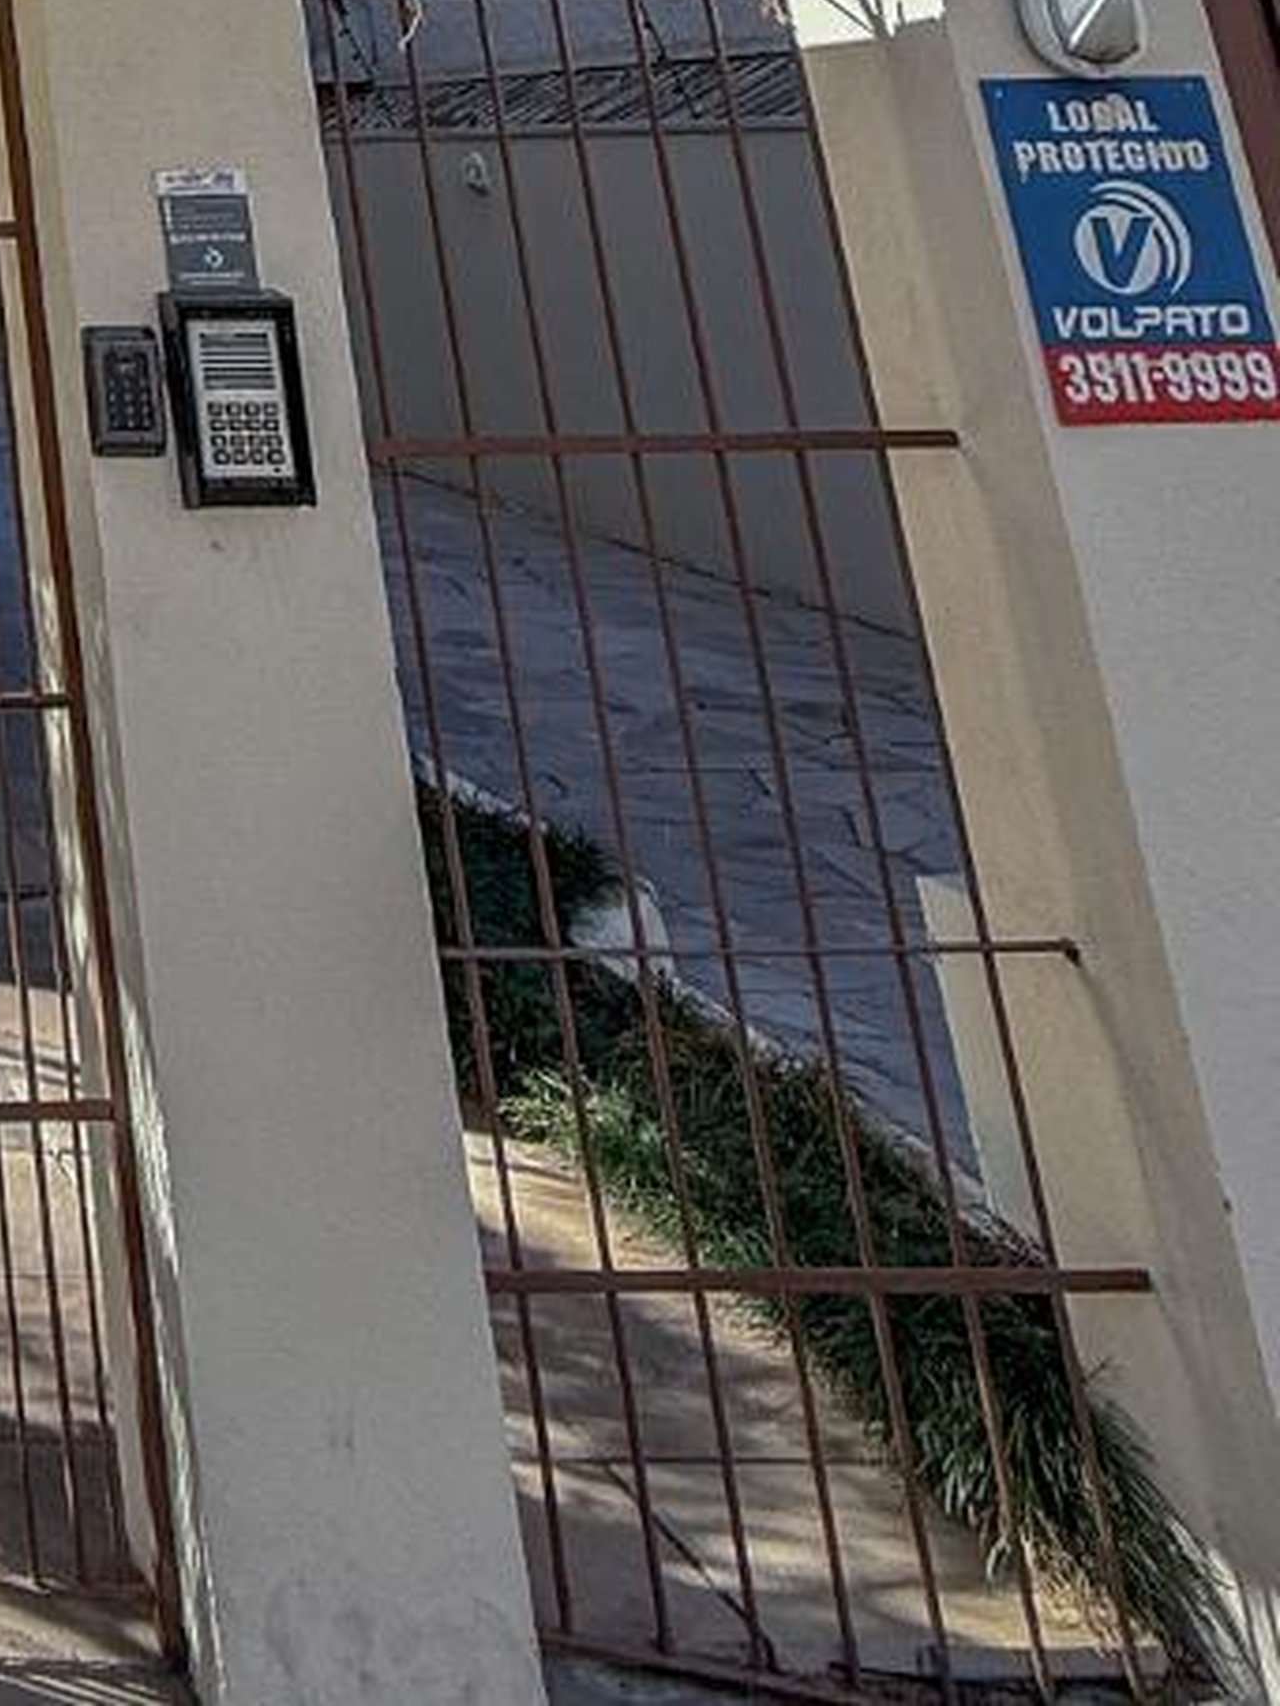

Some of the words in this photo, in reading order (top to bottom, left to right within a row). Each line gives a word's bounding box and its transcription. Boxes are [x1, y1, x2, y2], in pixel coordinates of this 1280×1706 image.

[1046, 99, 1160, 133] LOCAL
[1013, 139, 1210, 177] PROTEGIDO
[1051, 304, 1251, 338] VOLPATO
